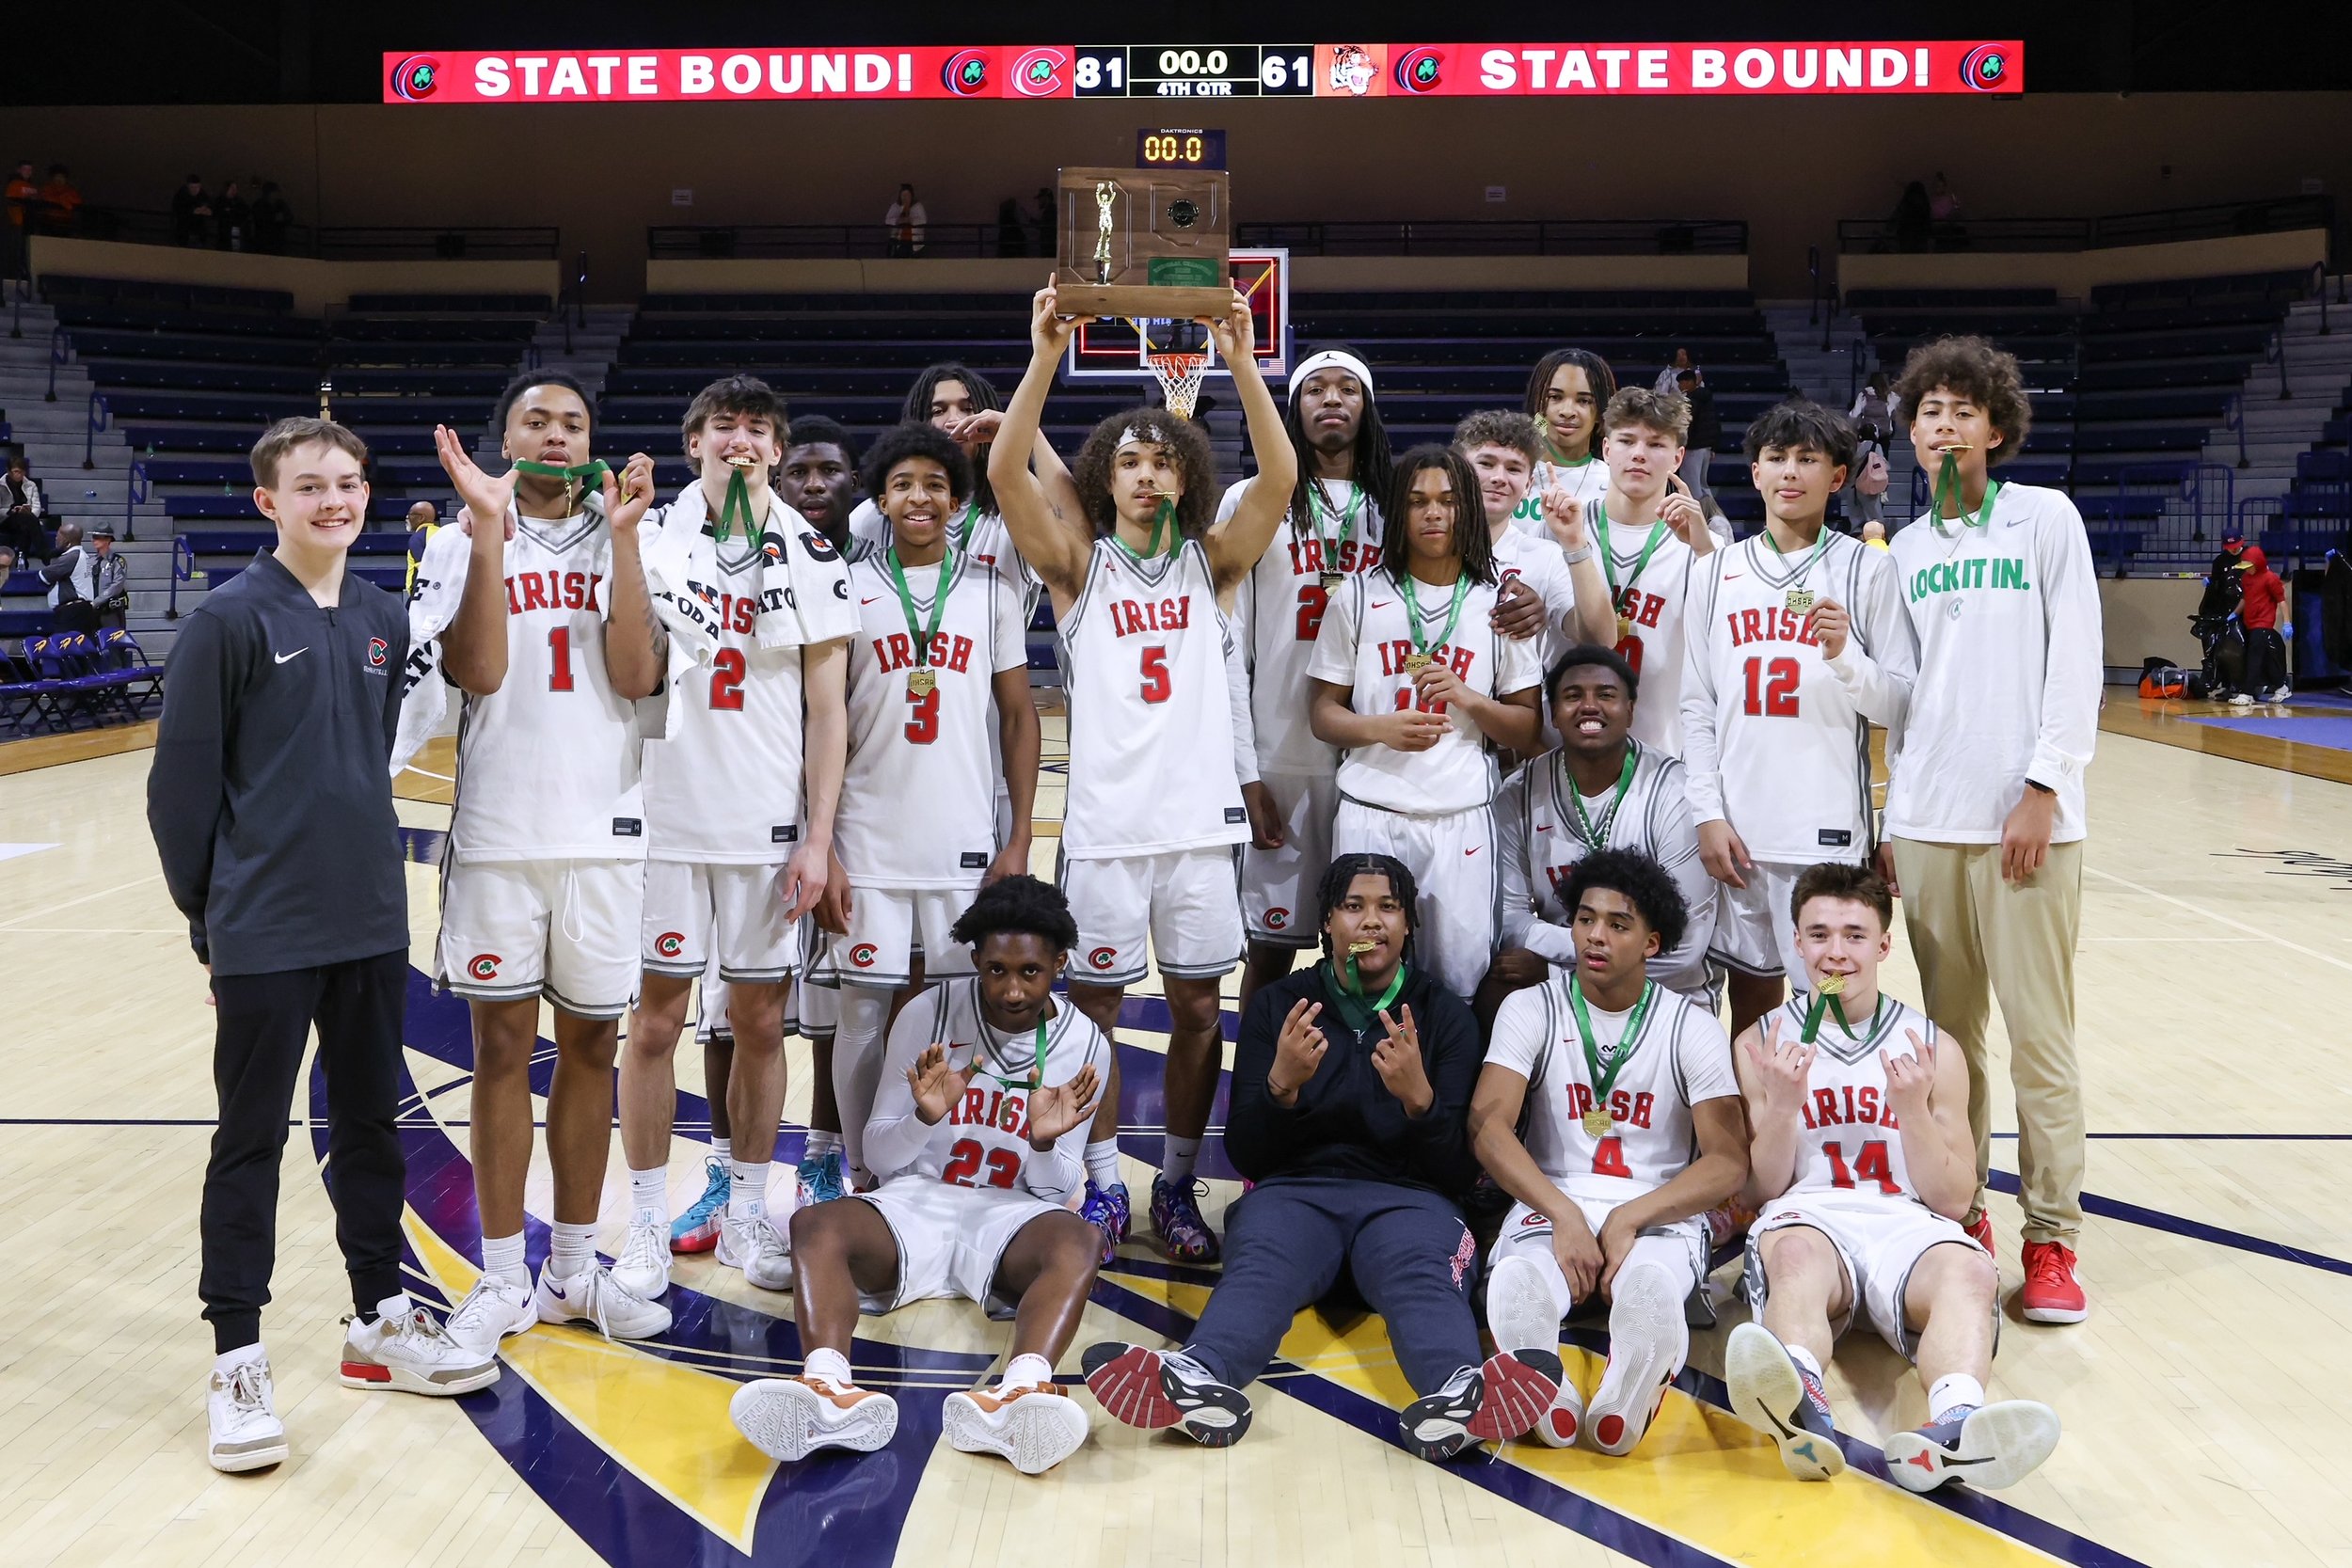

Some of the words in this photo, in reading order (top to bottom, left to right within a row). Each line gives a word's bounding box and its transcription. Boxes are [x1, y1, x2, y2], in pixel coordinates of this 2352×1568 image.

[473, 55, 658, 98] STATE
[679, 54, 912, 94] BOUND!
[1075, 56, 1122, 88] 81
[1158, 50, 1229, 74] 00.0
[1261, 55, 1309, 87] 61
[1480, 49, 1670, 90] STATE
[1691, 48, 1930, 87] BOUND!
[1156, 82, 1192, 96] 4TH
[1195, 82, 1232, 96] QTR
[1145, 135, 1201, 162] 00.0
[1287, 538, 1381, 576] IRSH
[1991, 558, 2030, 591] IN.
[548, 626, 574, 692] 1
[872, 631, 974, 675] IRSH
[1140, 645, 1172, 705] 5
[1377, 640, 1475, 684] IRSH
[708, 647, 747, 712] 2
[1742, 656, 1802, 719] 12
[904, 687, 941, 746] 3
[1566, 1082, 1655, 1130] IRSH
[942, 1137, 1022, 1190] 23
[1591, 1135, 1633, 1179] 4
[1821, 1139, 1902, 1195] 14
